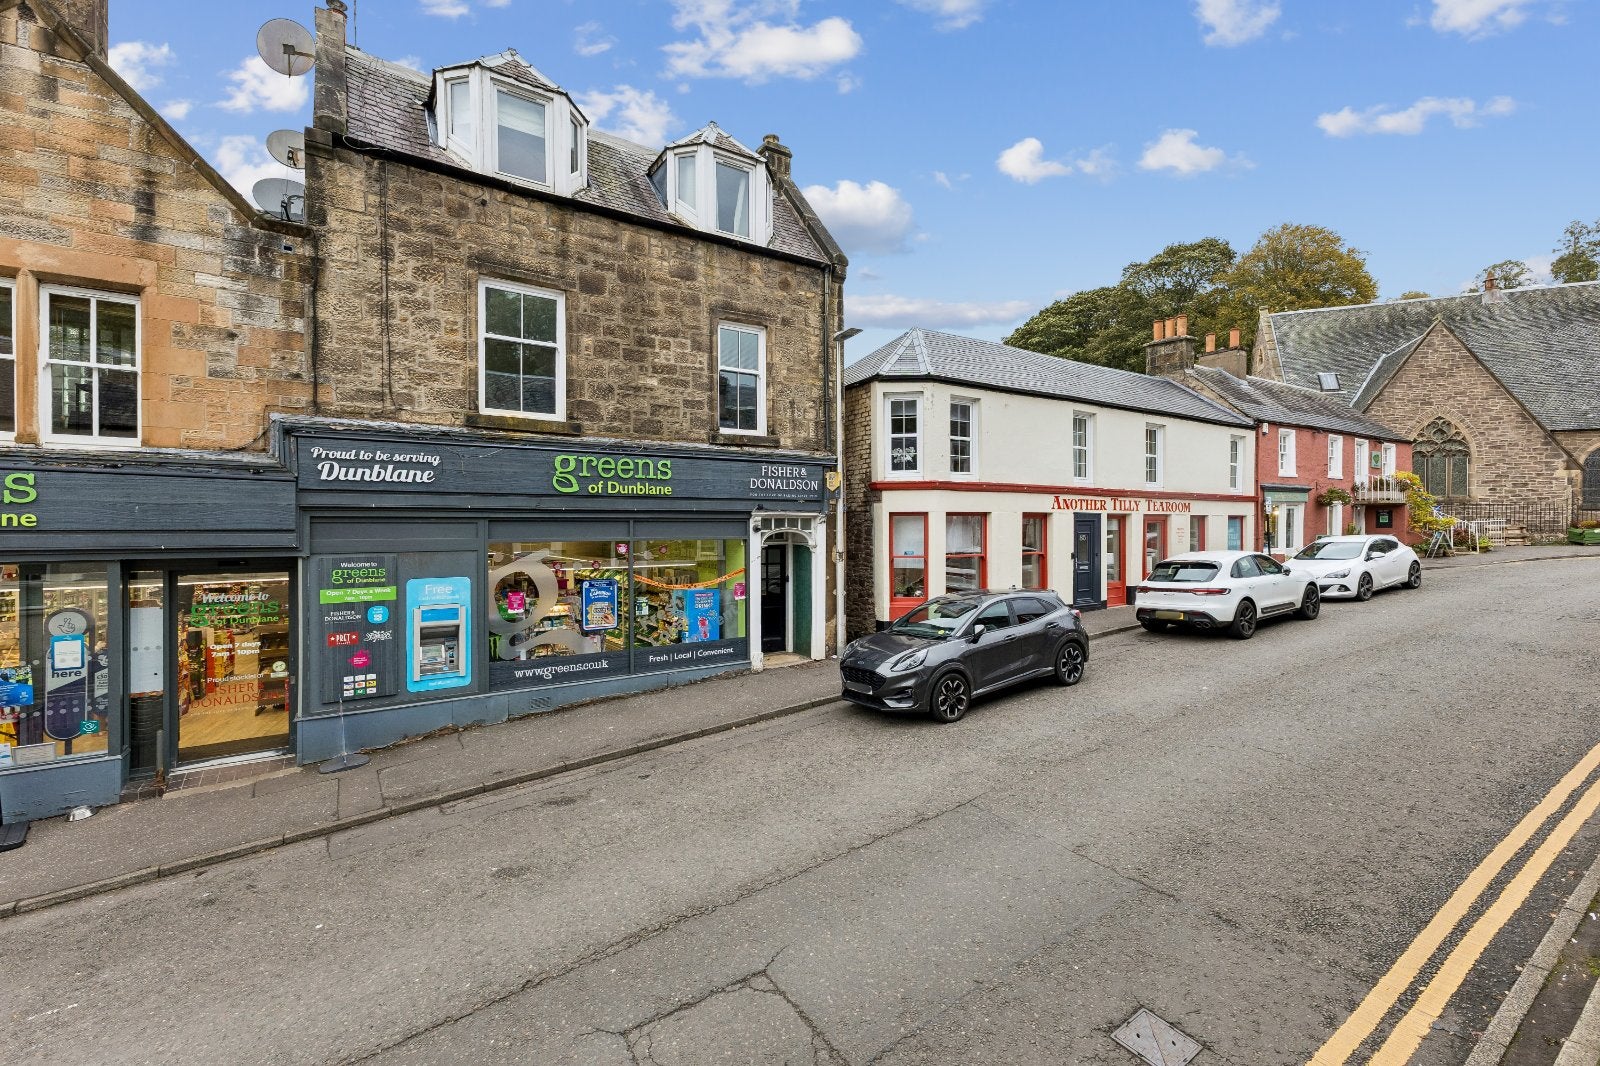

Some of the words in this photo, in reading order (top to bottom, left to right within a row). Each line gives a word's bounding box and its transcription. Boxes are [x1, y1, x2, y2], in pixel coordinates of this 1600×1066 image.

[310, 446, 357, 460] Proud
[359, 450, 373, 461] to
[375, 450, 392, 461] be
[393, 452, 441, 467] serving
[317, 460, 436, 483] Dunblane
[552, 454, 672, 493] greens
[761, 465, 799, 478] FISHER
[800, 467, 808, 478] &
[588, 481, 604, 494] of
[607, 481, 672, 495] Dunblane
[749, 478, 818, 491] DONALDSON
[1051, 495, 1107, 511] ANOTHER
[1111, 497, 1141, 512] TILLY
[1145, 499, 1191, 513] TEAROOM
[331, 568, 386, 584] greens
[425, 584, 453, 594] Free
[202, 592, 255, 604] Welcome
[258, 591, 270, 601] to
[190, 600, 280, 627] greens
[214, 617, 226, 625] of
[230, 615, 279, 625] Dunblane
[241, 641, 261, 649] days
[237, 648, 260, 656] 10pm
[649, 654, 668, 663] Fresh
[674, 651, 692, 660] Local
[697, 647, 734, 657] Convenient
[52, 670, 82, 679] here
[206, 675, 229, 683] Proud
